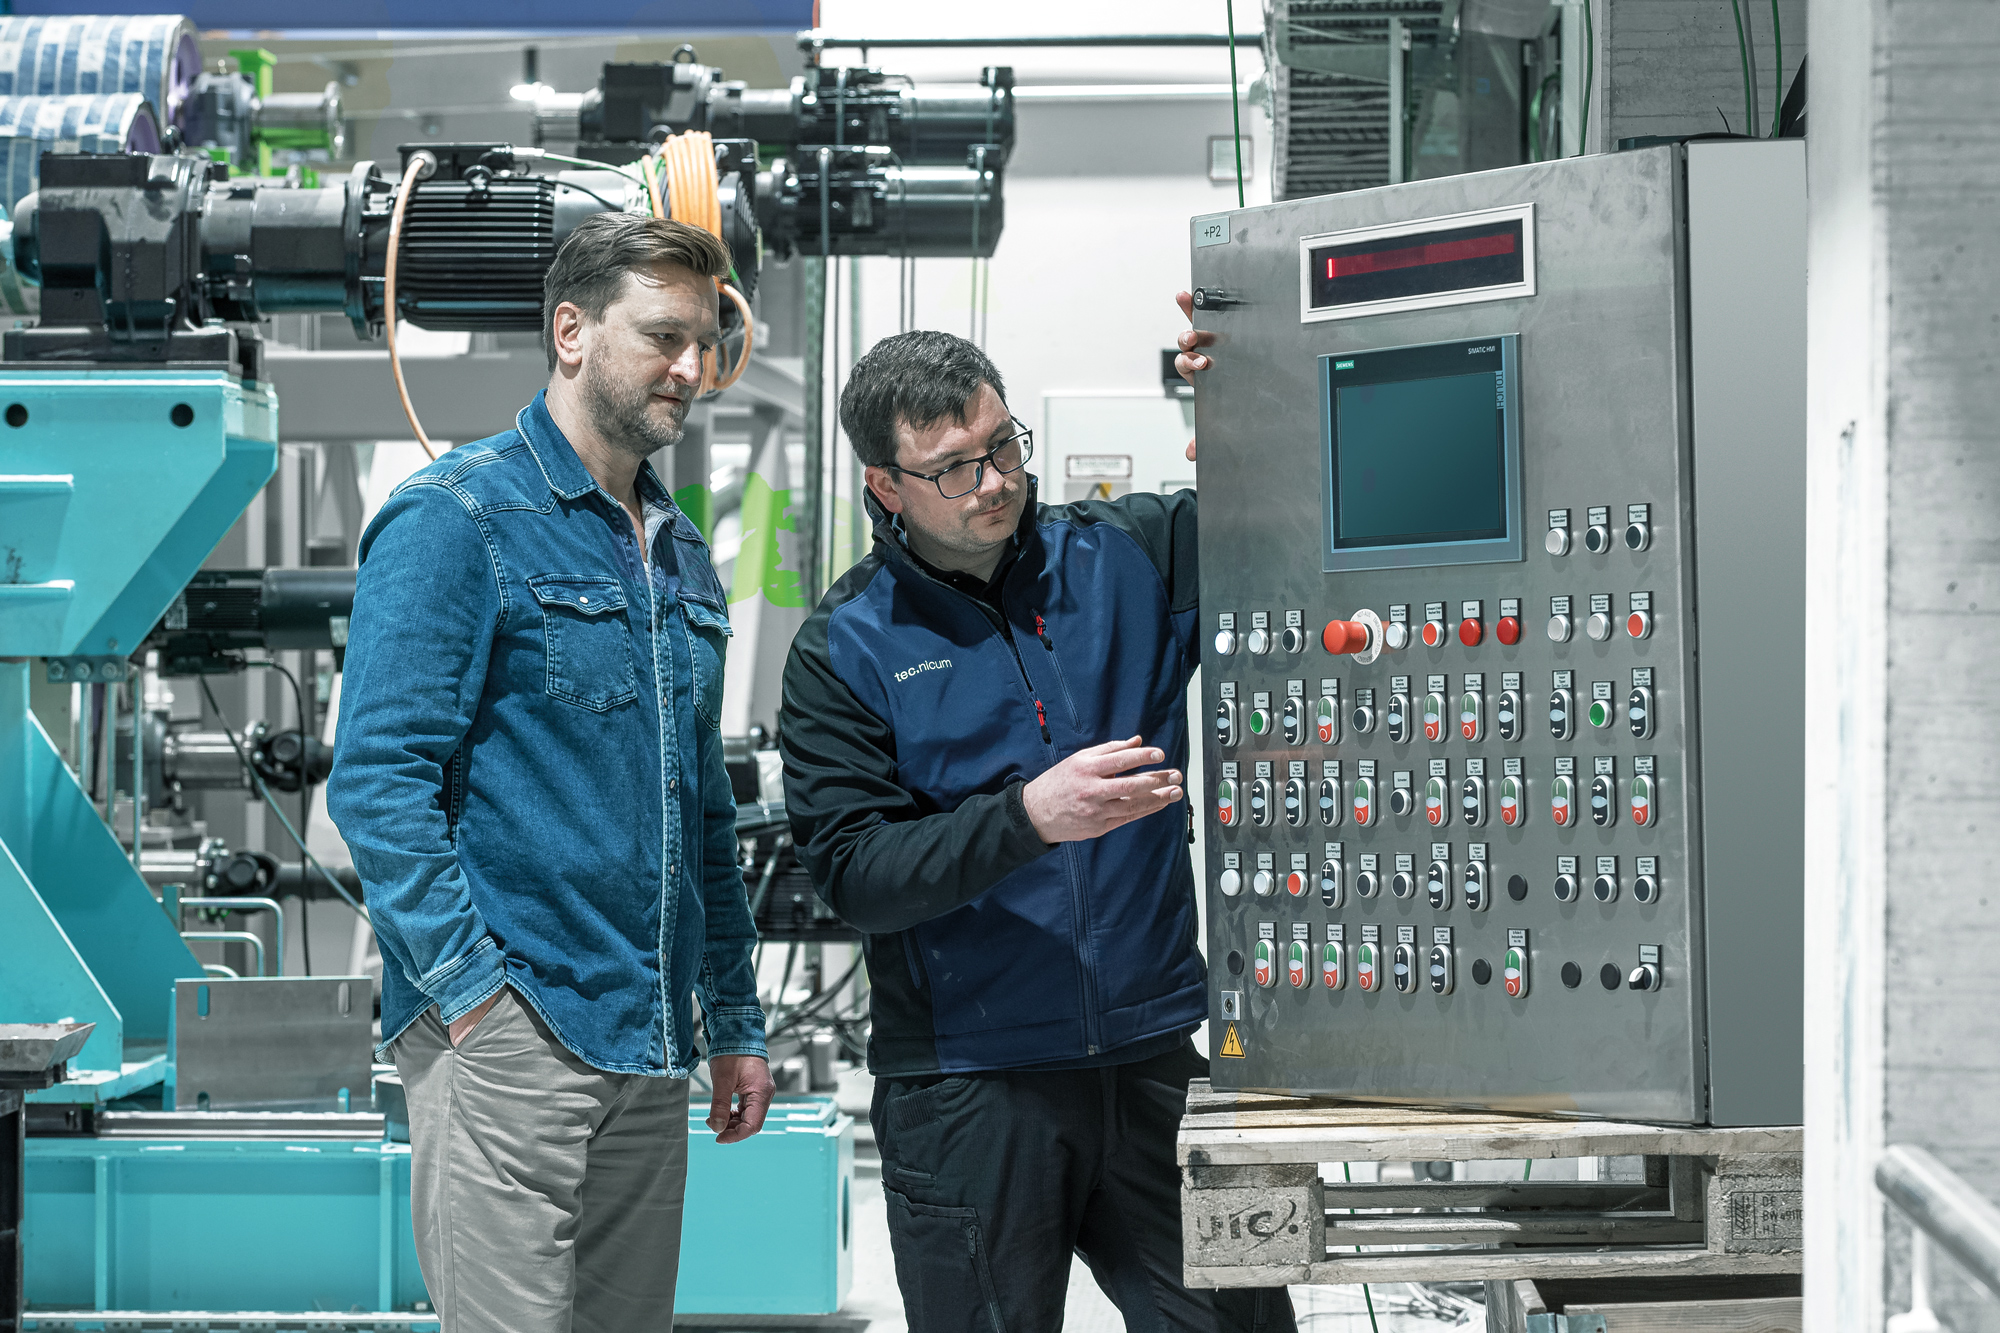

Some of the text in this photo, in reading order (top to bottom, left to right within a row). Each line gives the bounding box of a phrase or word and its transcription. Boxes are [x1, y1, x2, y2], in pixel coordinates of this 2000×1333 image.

[1204, 225, 1221, 238] +P2
[1496, 371, 1504, 409] TOUCH
[894, 659, 952, 682] tec.nicum
